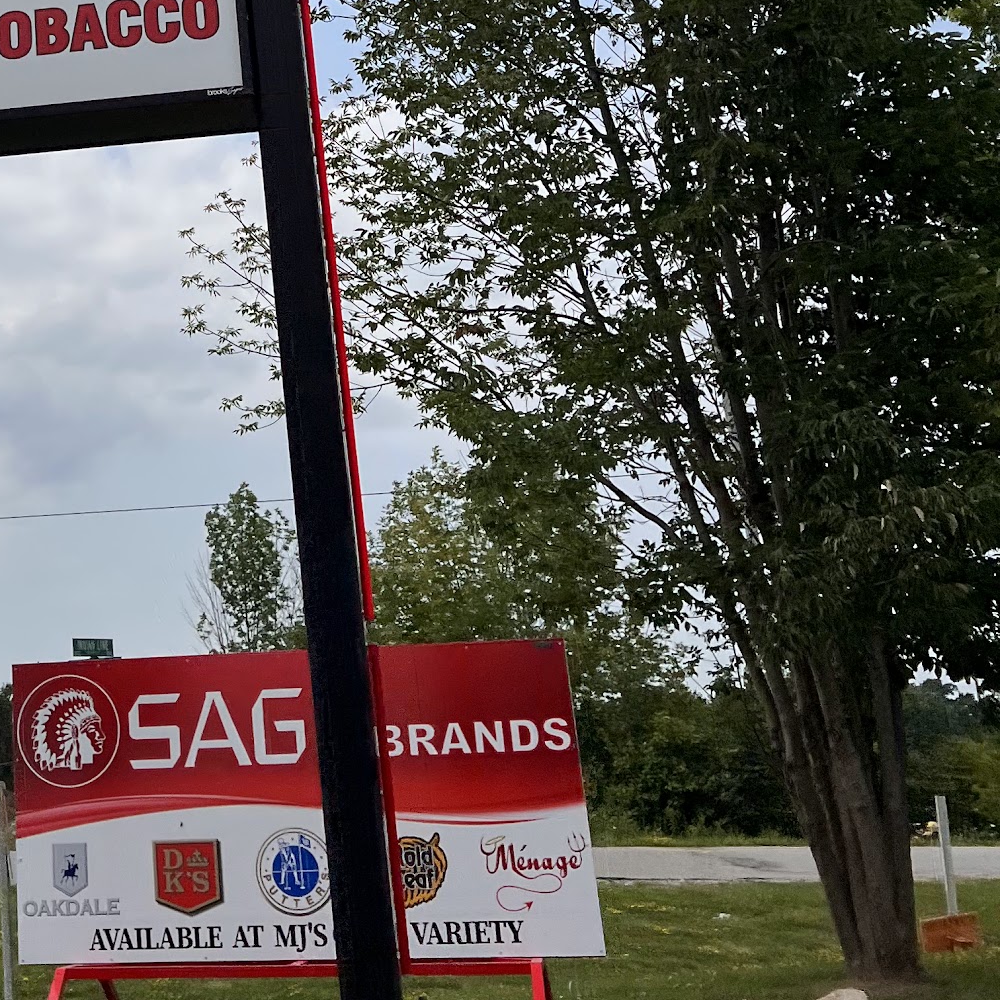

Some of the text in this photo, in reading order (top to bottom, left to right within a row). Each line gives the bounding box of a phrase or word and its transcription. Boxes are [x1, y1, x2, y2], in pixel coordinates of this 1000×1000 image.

[375, 717, 572, 757] BRANDS
[163, 849, 184, 870] D
[401, 845, 434, 868] old
[487, 843, 582, 879] Ménage
[163, 871, 210, 894] K'S
[263, 872, 330, 908] PUTTER'S
[402, 868, 435, 889] eaf
[23, 898, 121, 917] OAKDALE
[89, 920, 524, 952] AVAILABLE AT MJ'S VARIETY
